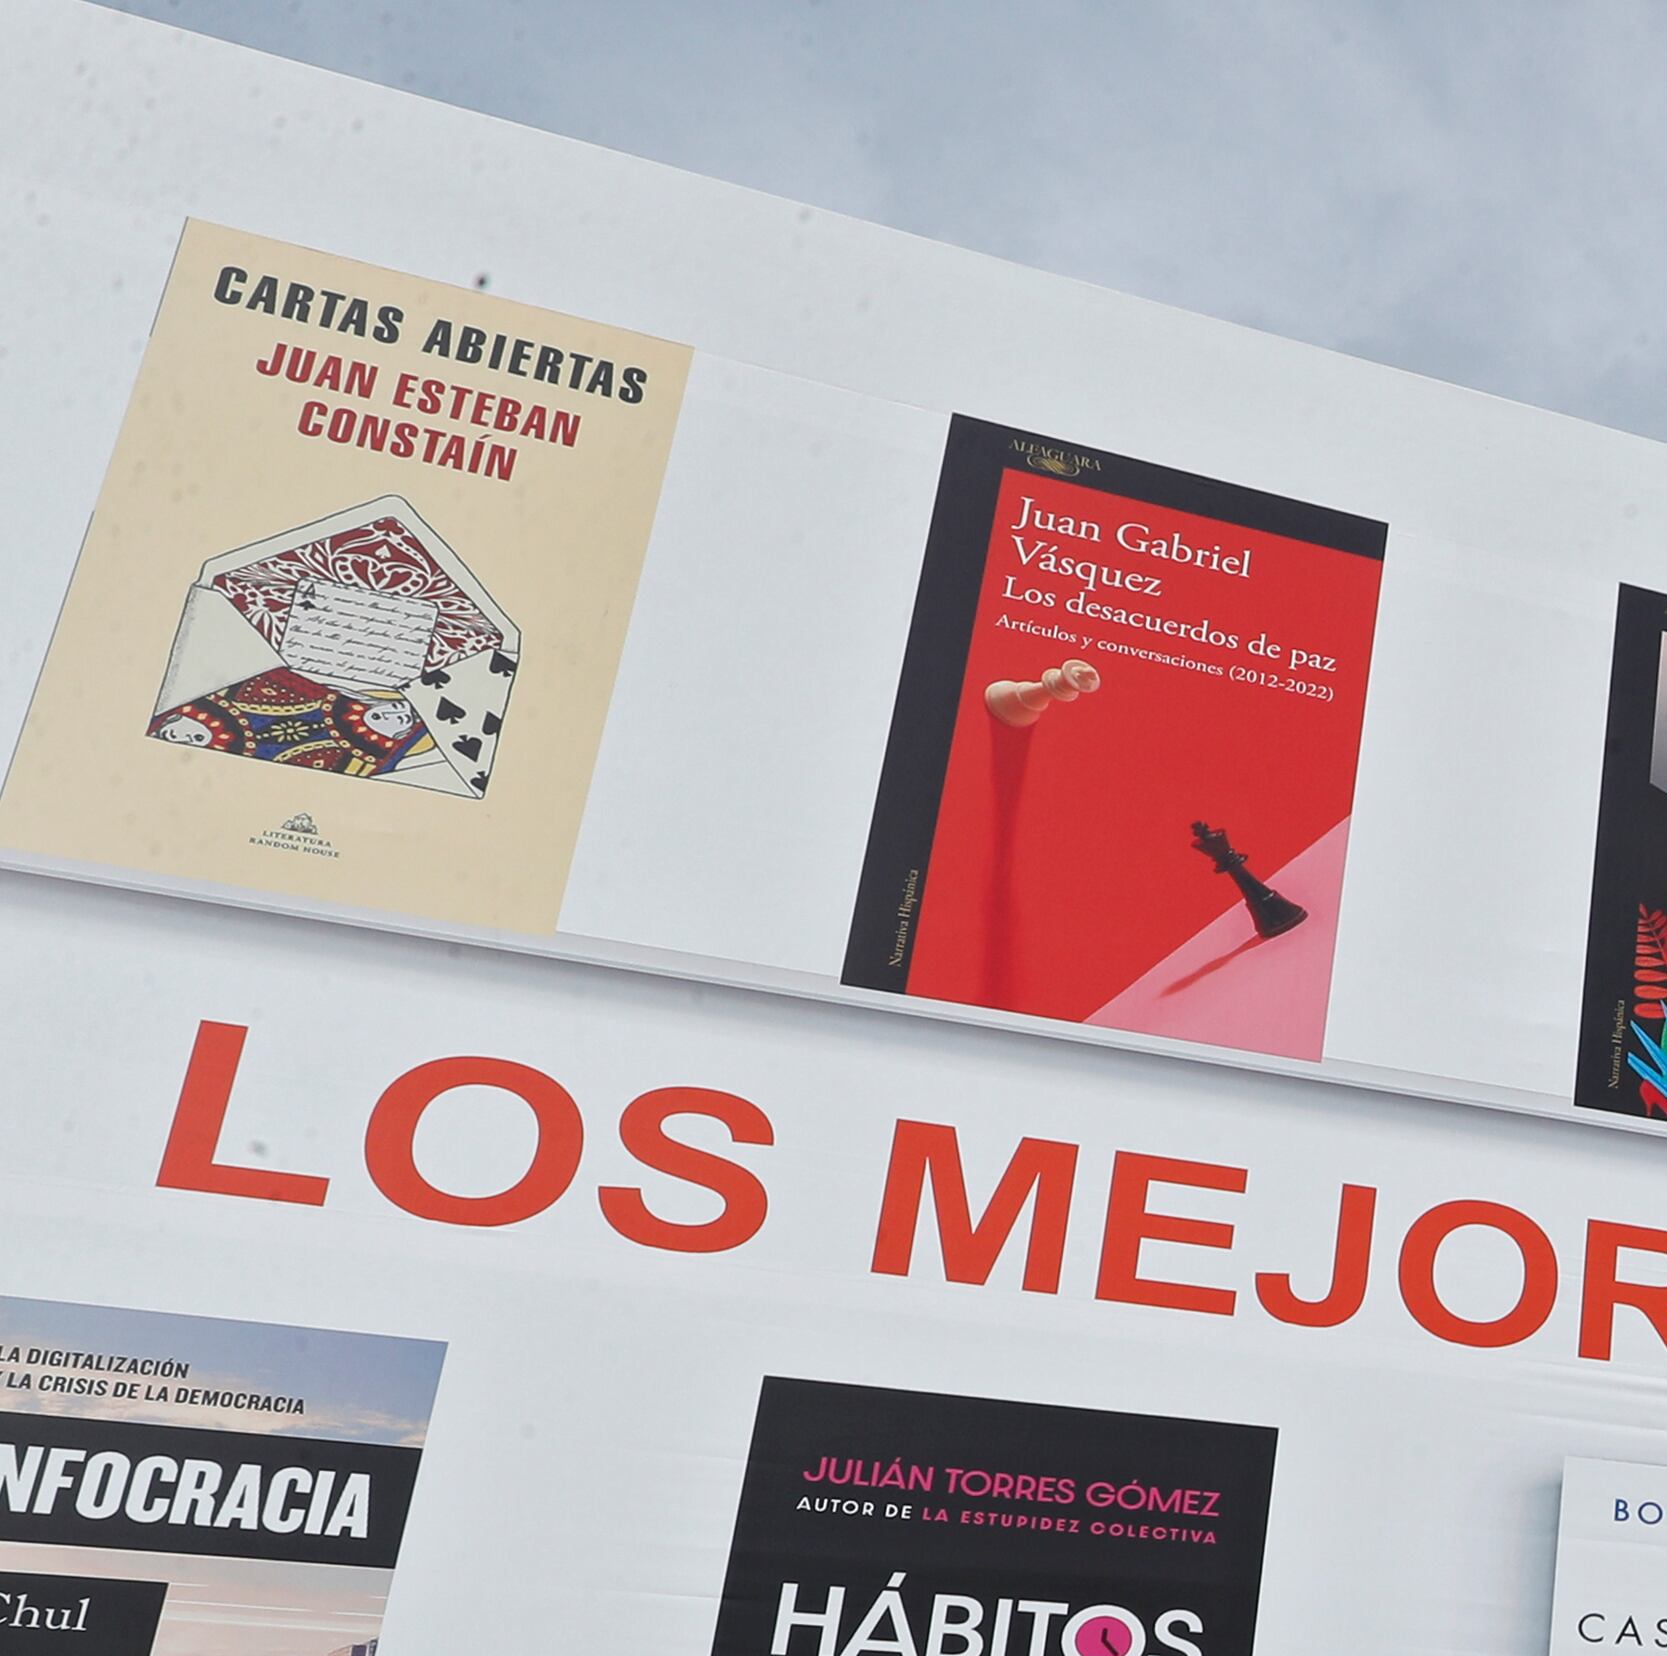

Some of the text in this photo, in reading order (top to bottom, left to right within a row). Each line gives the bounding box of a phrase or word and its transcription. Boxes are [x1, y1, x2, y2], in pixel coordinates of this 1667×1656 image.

[213, 266, 648, 404] CARTAS ABIERTAS
[256, 344, 581, 447] JUAN ESTEBAN
[297, 401, 518, 481] CONSTAÍN
[1011, 496, 1251, 578] Juan Gabriel
[1011, 536, 1162, 598] Vásquez
[995, 613, 1335, 702] Artículos conversaciones (2012-2022)
[1003, 576, 1337, 673] Los desacuerdos de paz
[249, 837, 340, 858] RANDOM HOUSE
[263, 830, 331, 847] LITERATURA
[158, 1020, 775, 1254] LOS
[6, 1373, 306, 1416] LA CRISIS DE LA DEMOCRACIA
[27, 1348, 189, 1379] DIGITALIZACIÓN
[796, 1496, 1217, 1544] AUTOR DE LA ESTUPIDEZ COLECTIVA
[802, 1457, 1222, 1519] JULIÁN TORRES GÓMEZ
